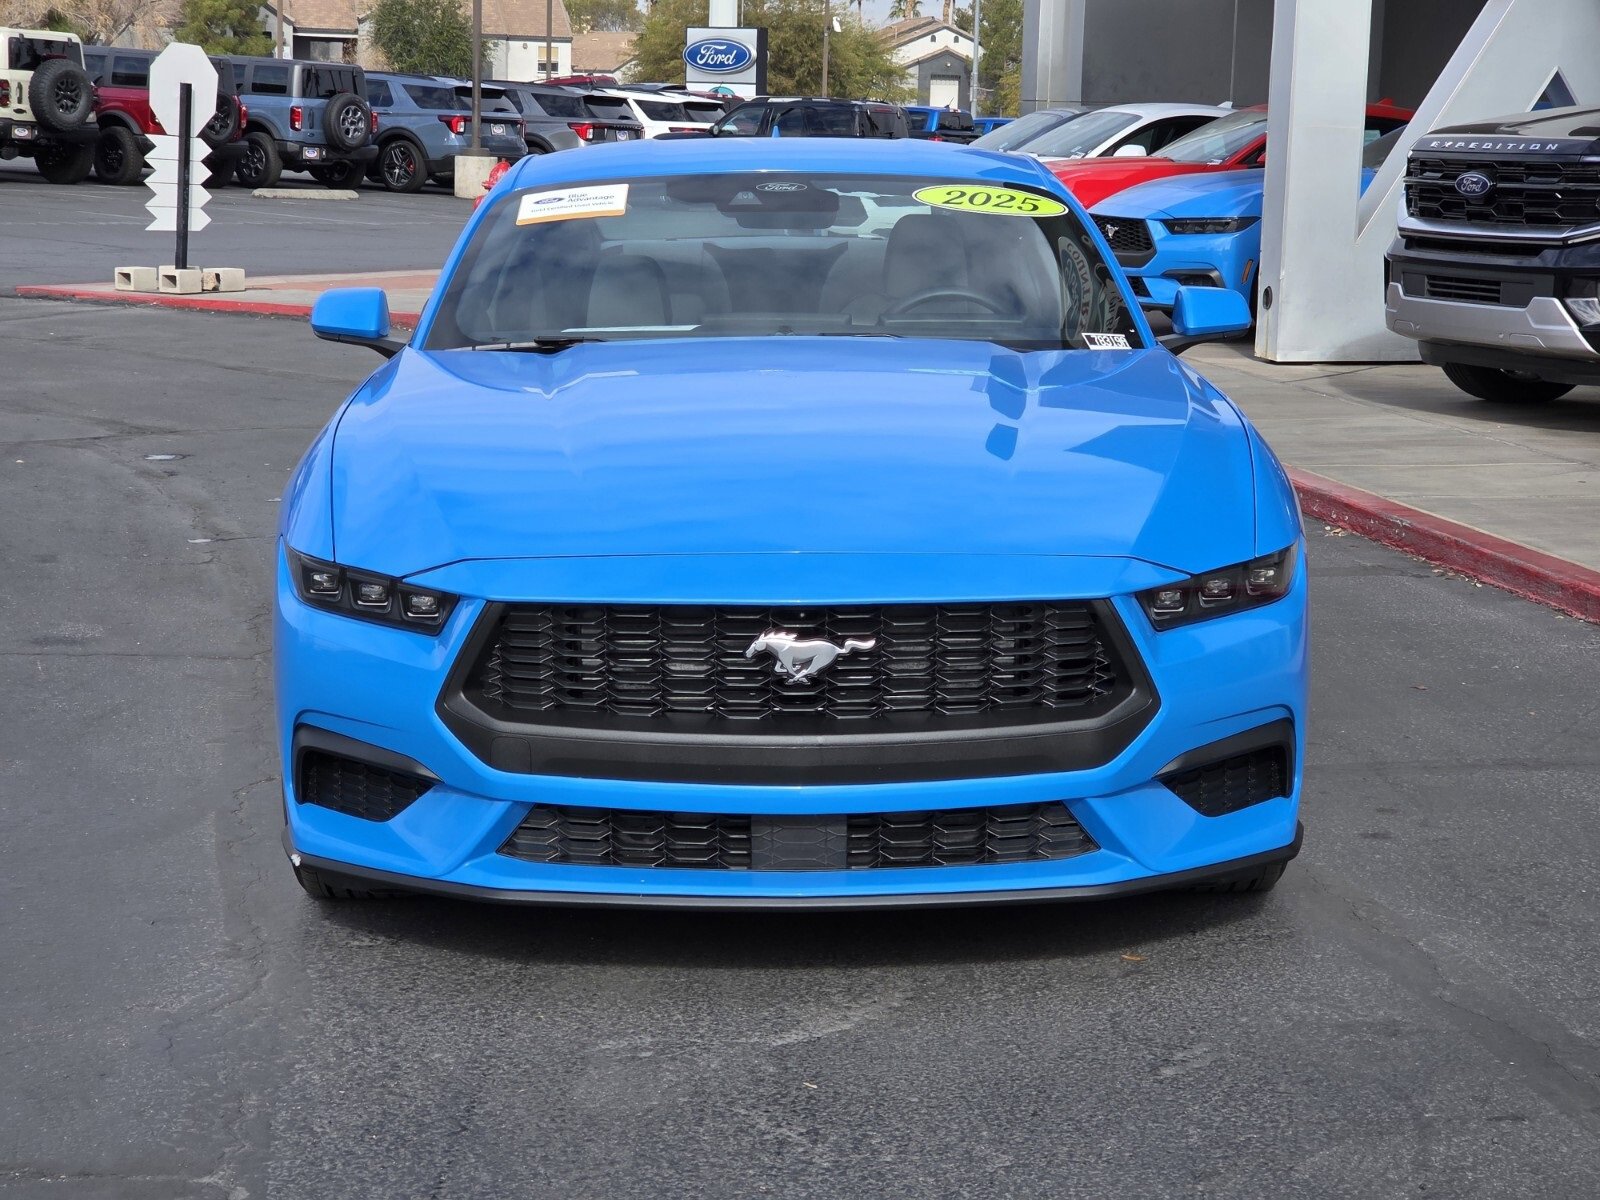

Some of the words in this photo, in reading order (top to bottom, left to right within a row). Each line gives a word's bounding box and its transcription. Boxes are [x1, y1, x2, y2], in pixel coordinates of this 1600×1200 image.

[696, 44, 737, 65] Ford
[1429, 140, 1560, 151] EXPEDITION
[1460, 176, 1483, 193] Ford
[567, 195, 615, 203] Advantage
[941, 189, 1041, 212] 2025
